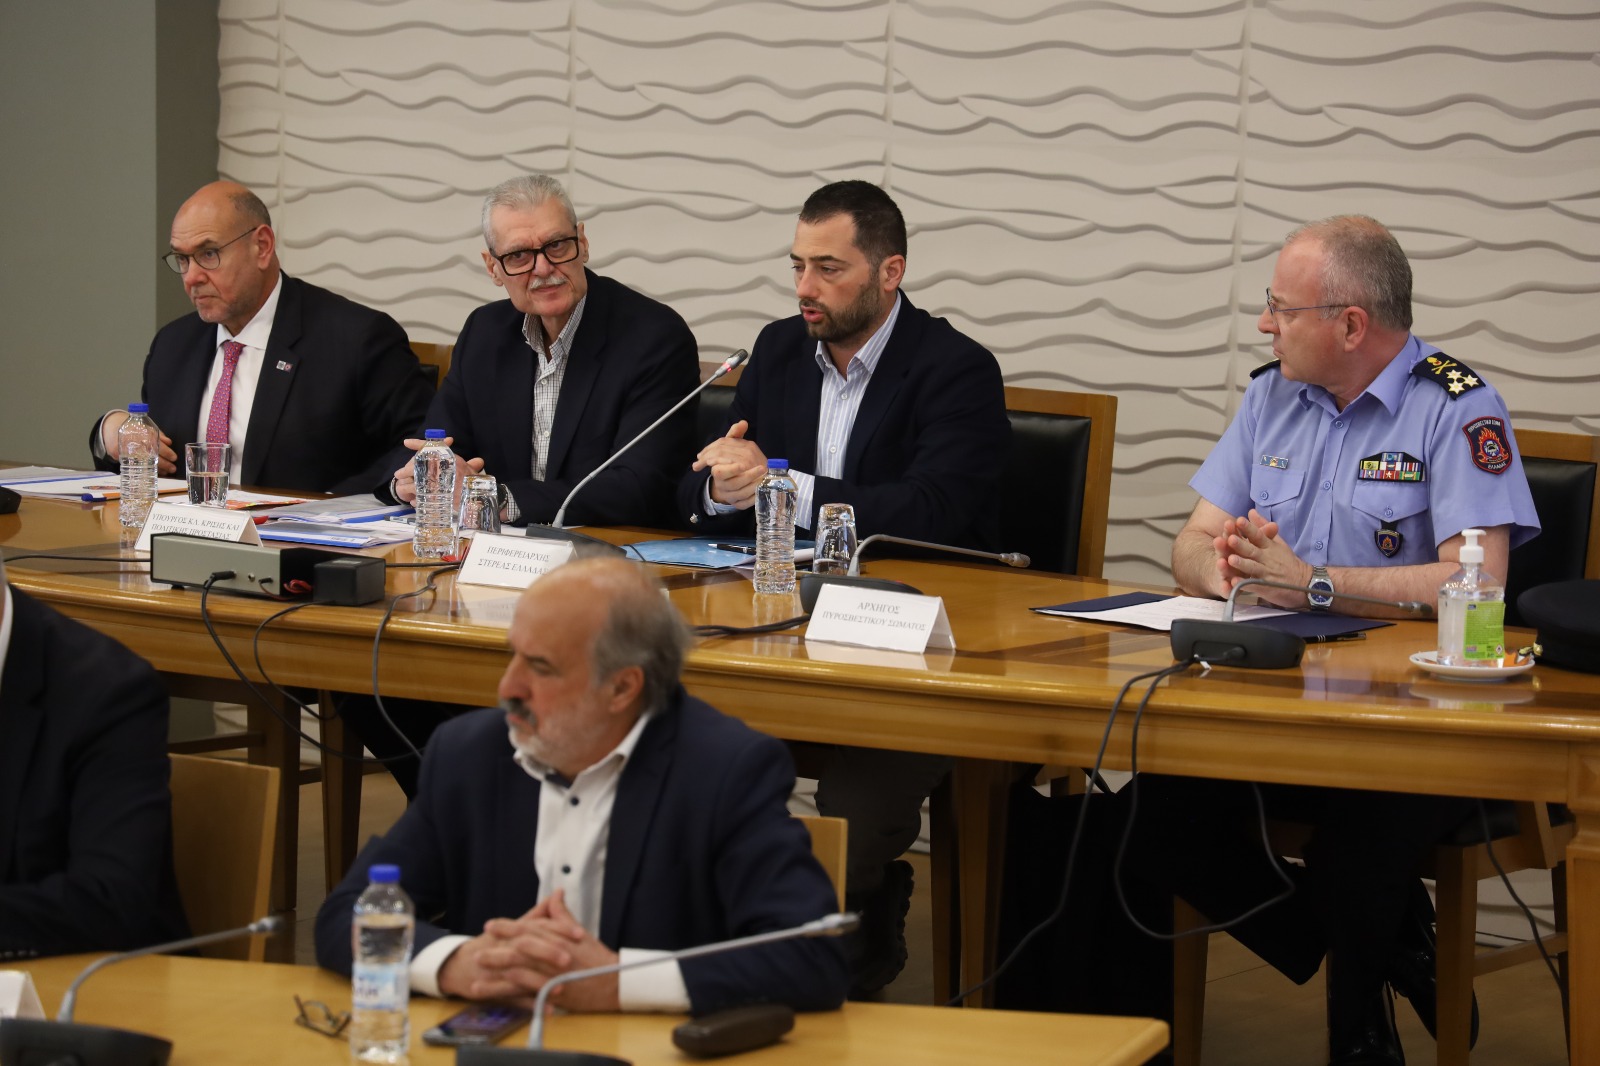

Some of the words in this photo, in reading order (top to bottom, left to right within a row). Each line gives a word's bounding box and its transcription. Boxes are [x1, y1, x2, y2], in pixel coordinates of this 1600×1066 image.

[152, 513, 187, 525] ΥΠΟΥΡΓΟΣ
[188, 518, 199, 526] ΚΛ.
[201, 519, 225, 530] ΚΡΙΣΗΣ
[226, 523, 240, 532] ΚΑΙ
[151, 523, 188, 535] ΠΟΛΙΤΙΚΗΣ
[188, 527, 232, 540] ΠΡΟΣΤΑΣΙΑΣ
[486, 546, 551, 563] ΠΕΡΙΦΕΡΕΙΑΡΧΗΣ
[477, 558, 511, 570] ΣΤΕΡΕΑΣ
[857, 602, 901, 615] ΑΡΧΗΓΟΣ
[822, 610, 887, 626] ΠΥΡΟΣΒΕΣΤΙΚΟΥ
[887, 619, 927, 631] ΣΩΜΑΤΟΣ
